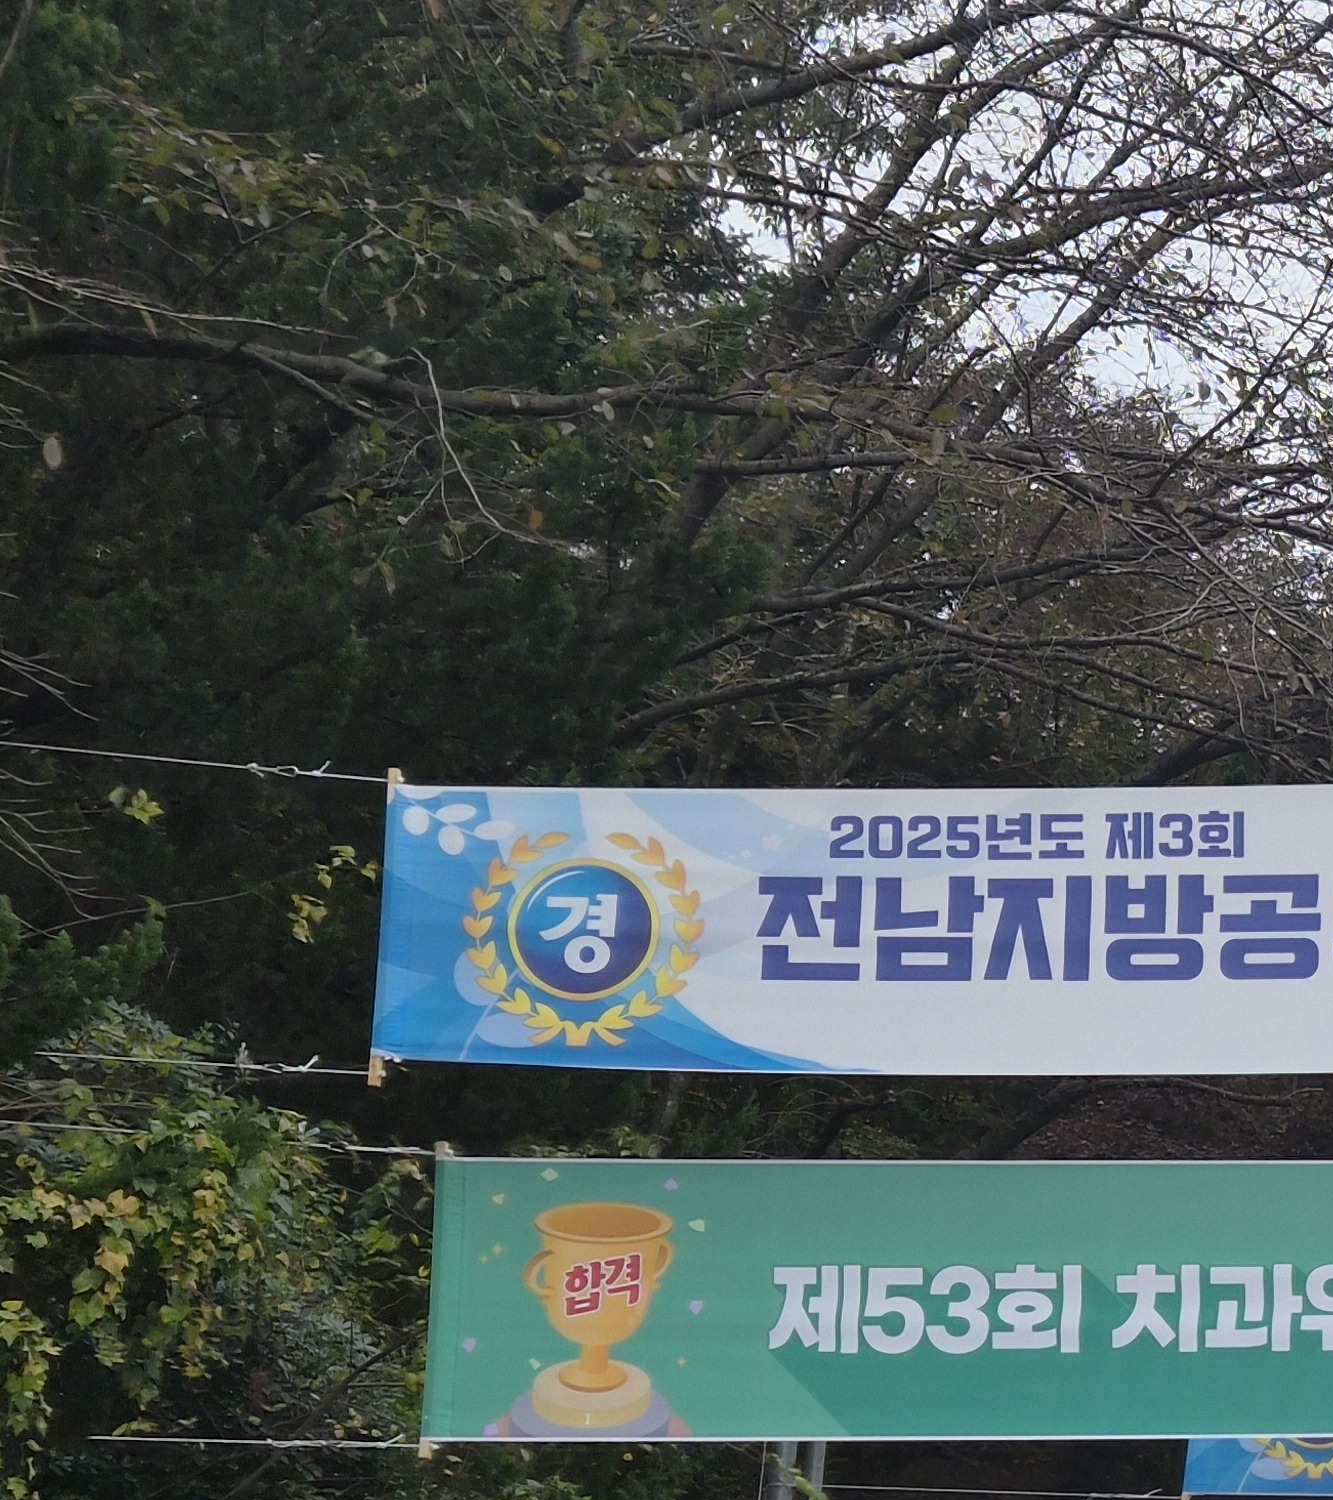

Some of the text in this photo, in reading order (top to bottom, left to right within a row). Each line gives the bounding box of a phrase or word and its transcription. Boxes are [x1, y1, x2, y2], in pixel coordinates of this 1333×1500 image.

[829, 811, 1245, 861] 2025년도 제3회
[538, 891, 618, 975] 경
[562, 1253, 642, 1318] 합격
[769, 1264, 1082, 1353] 제53회
